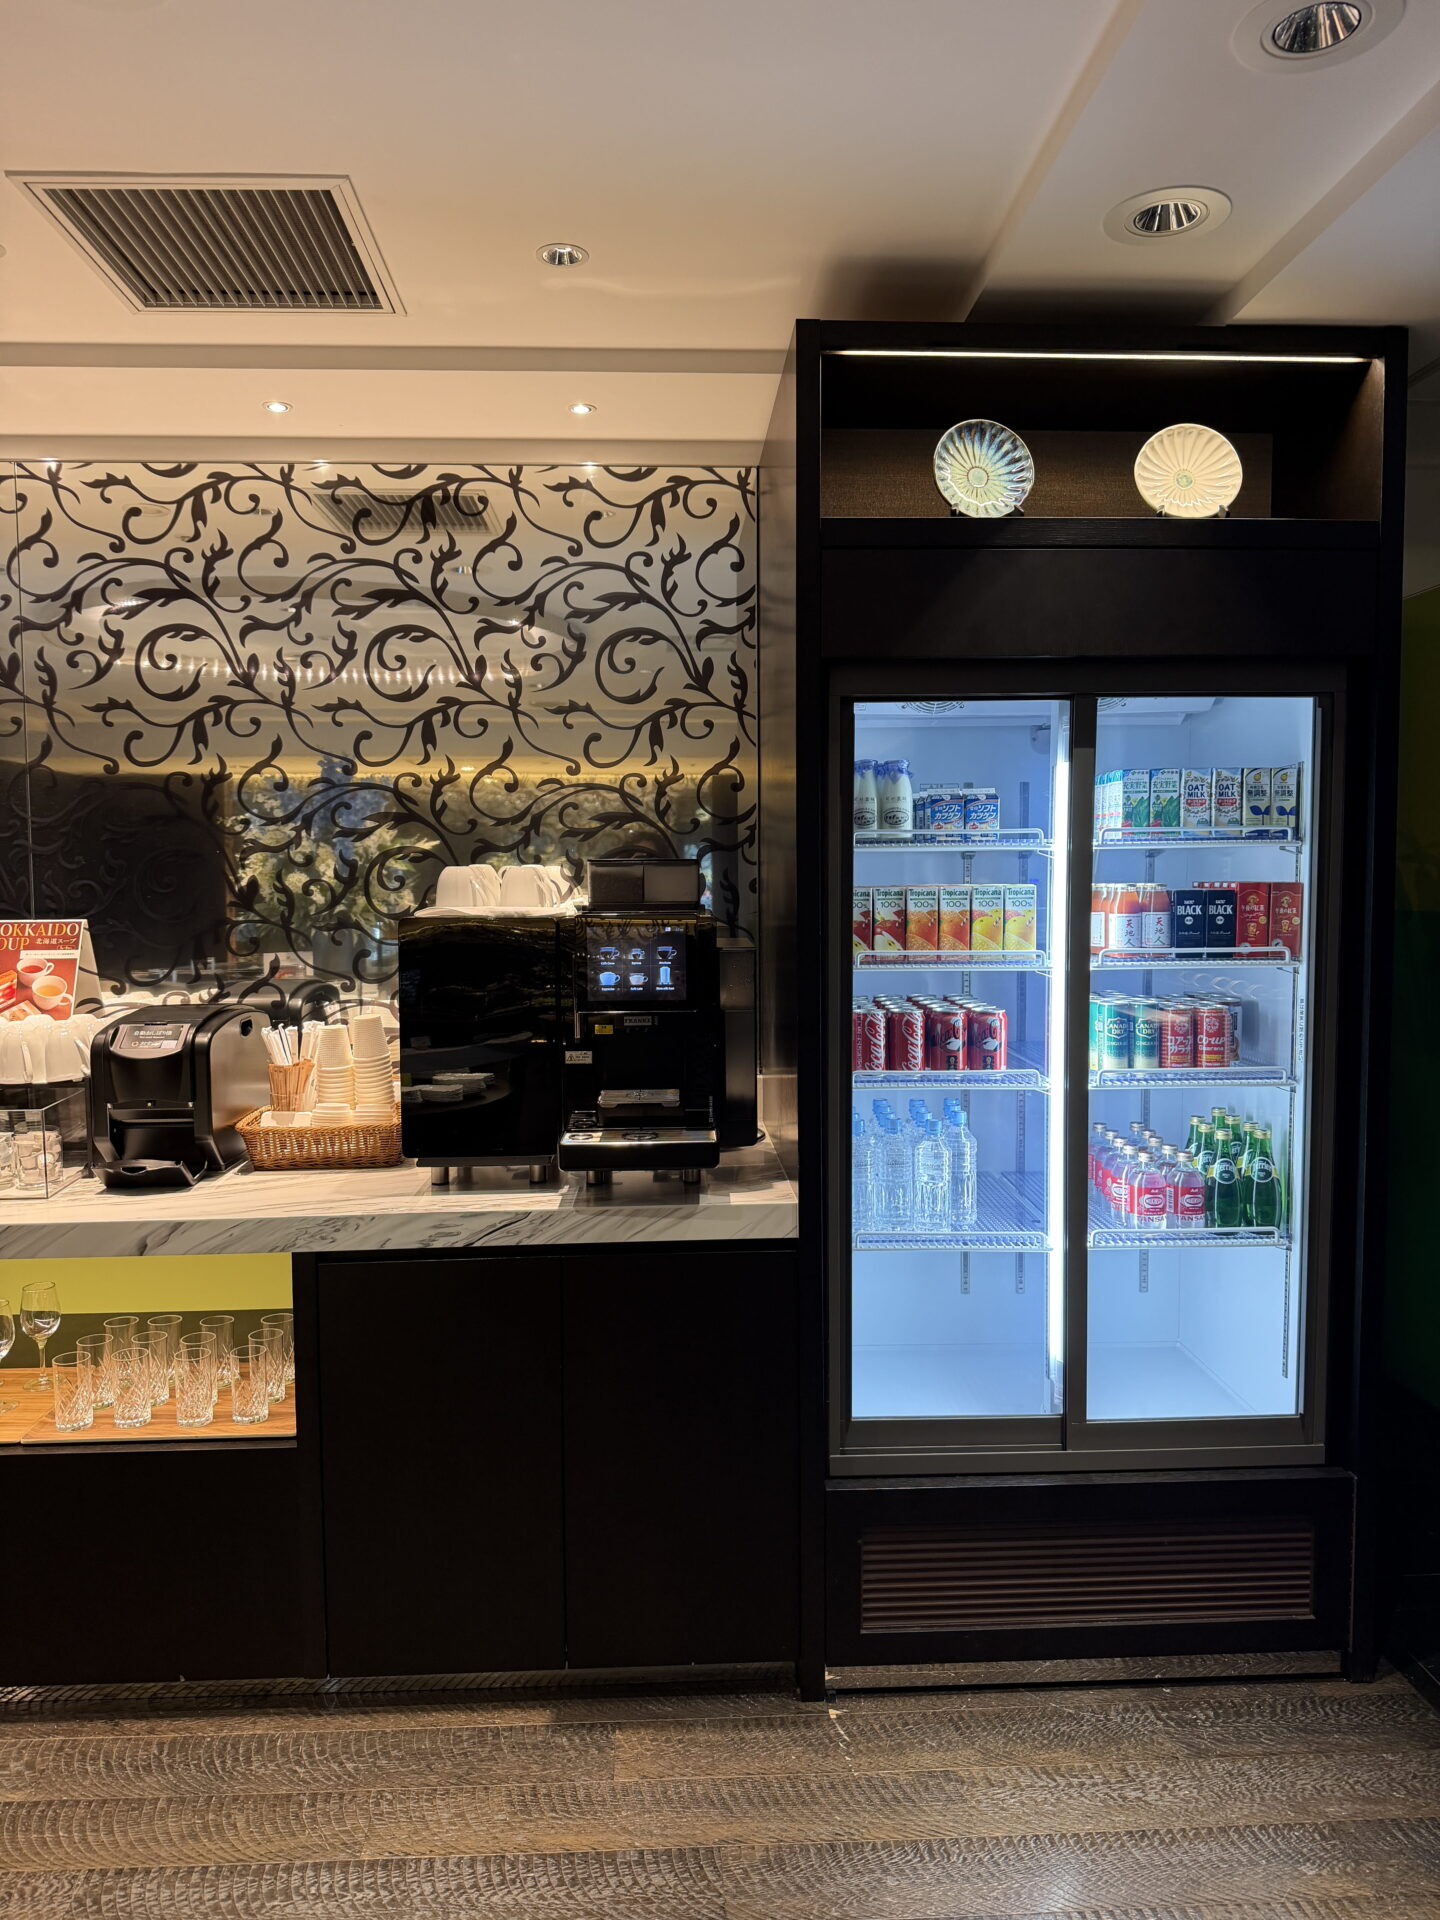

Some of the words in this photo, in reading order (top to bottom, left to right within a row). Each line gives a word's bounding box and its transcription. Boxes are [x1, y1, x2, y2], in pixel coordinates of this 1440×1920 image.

[1187, 783, 1206, 791] OAT
[1218, 783, 1236, 791] OAT
[876, 888, 904, 897] Tropicana
[908, 888, 937, 897] Tropicana
[941, 888, 969, 897] Tropicana
[974, 887, 1002, 896] Tropicana
[1007, 887, 1035, 896] Tropicana
[880, 901, 901, 909] 100%
[913, 901, 934, 909] 100%
[945, 900, 967, 908] 100%
[978, 900, 999, 908] 100%
[1011, 899, 1033, 907] 100%
[1177, 905, 1202, 915] BLACK
[1208, 904, 1233, 914] BLACK
[0, 923, 80, 937] OKKAIDO
[0, 937, 30, 951] OUP
